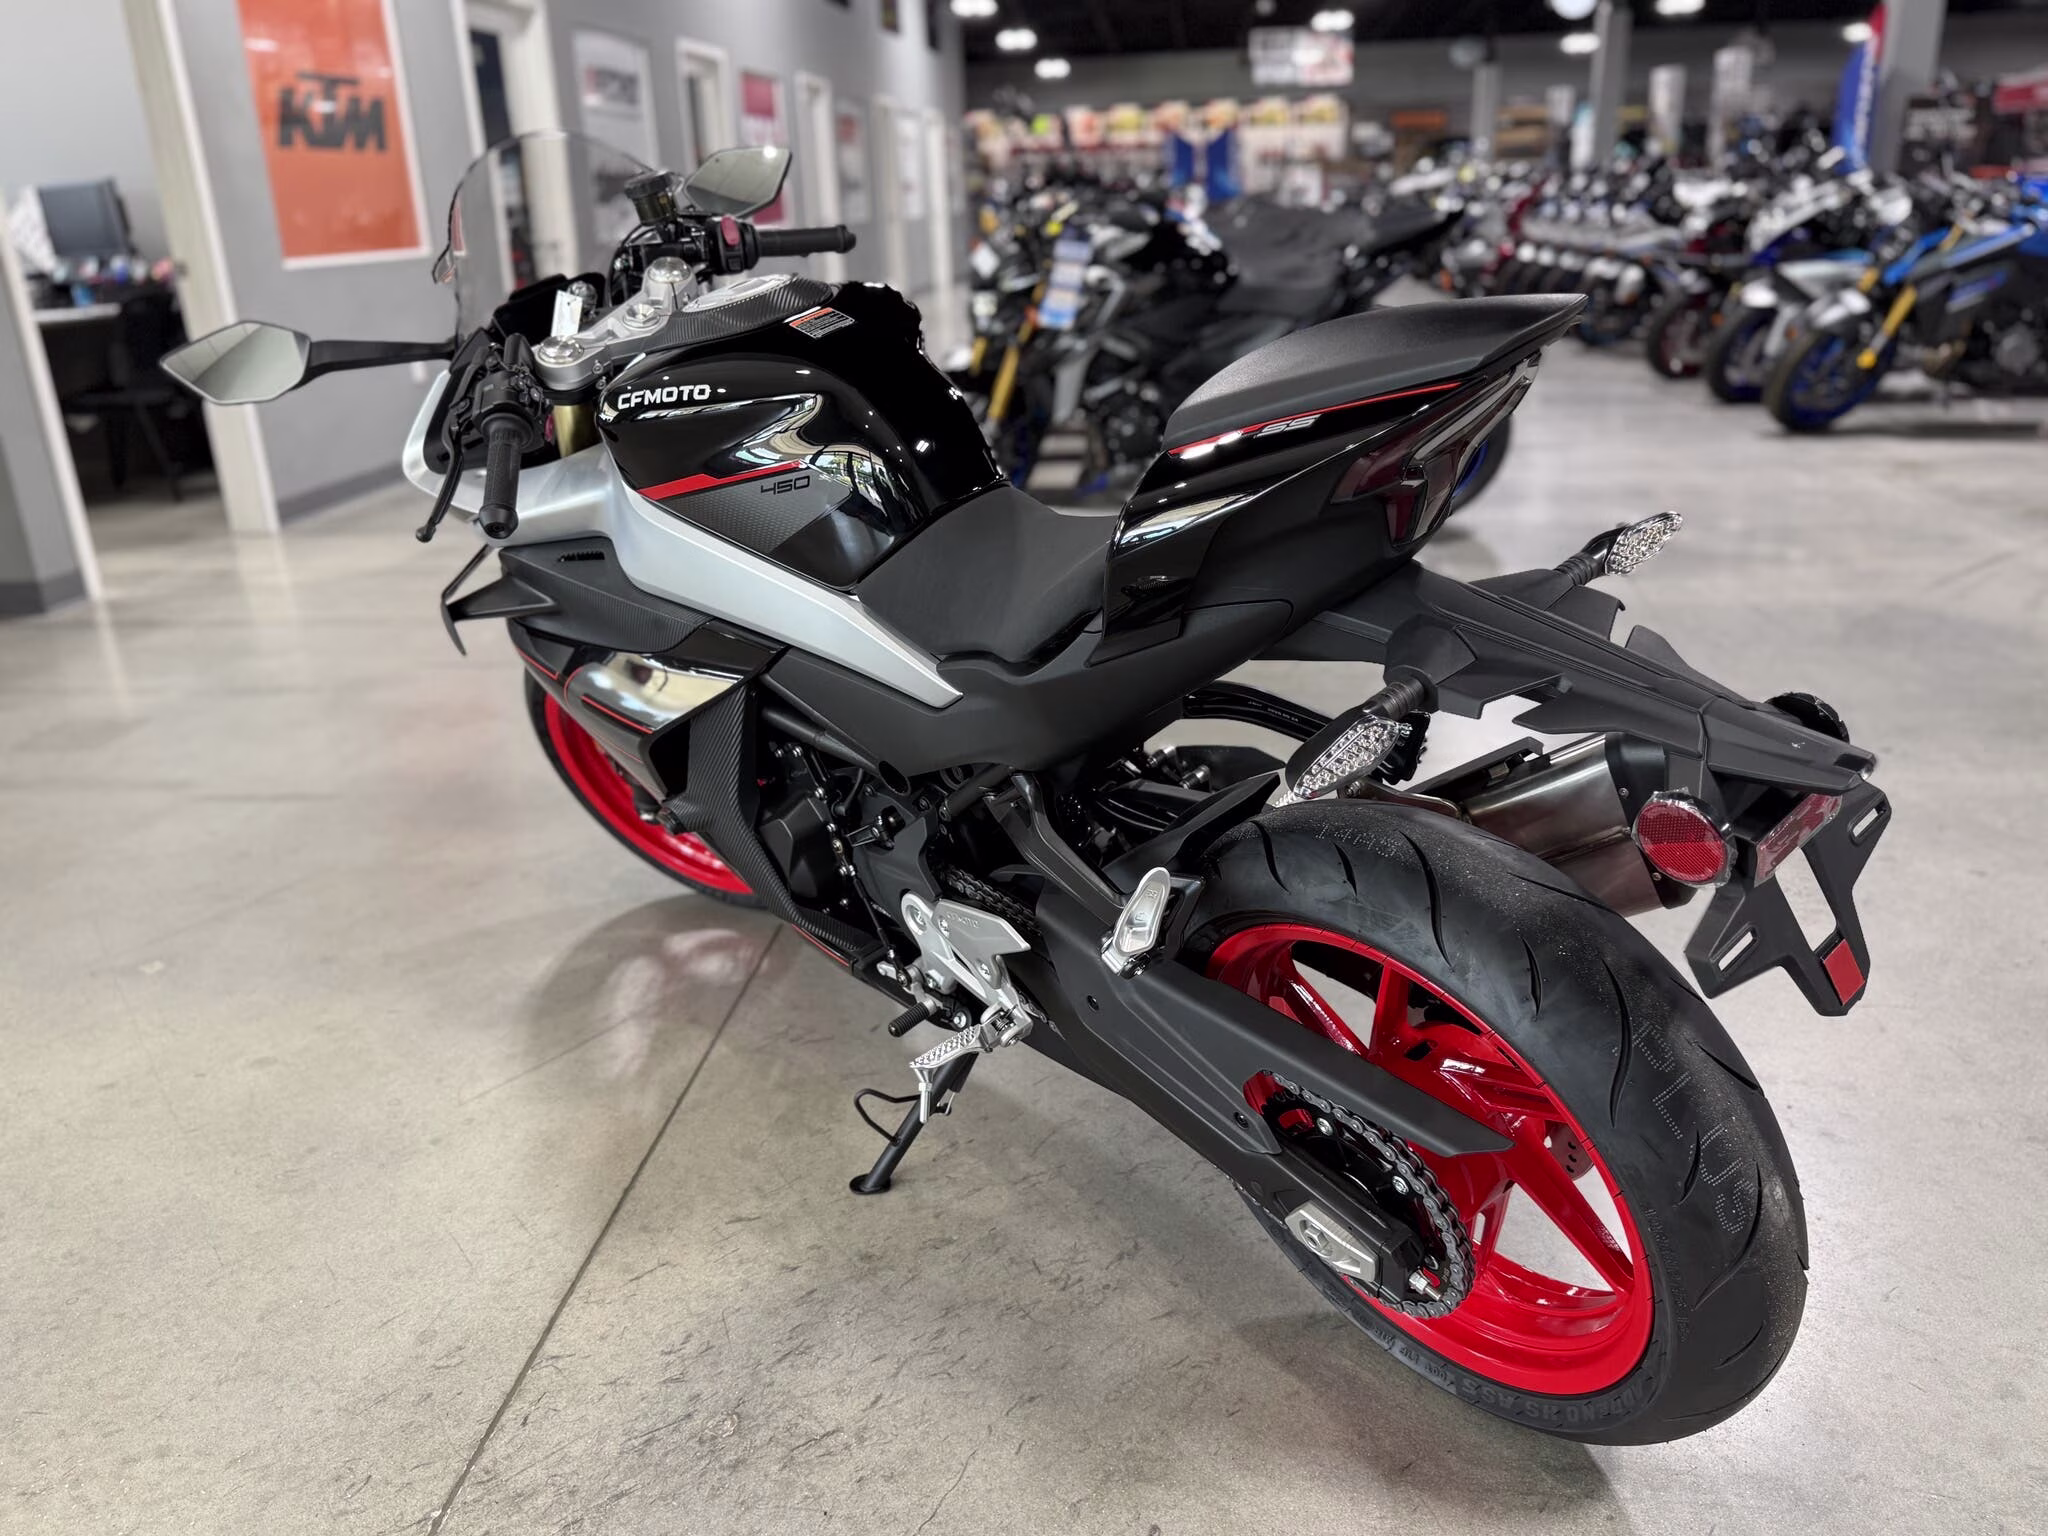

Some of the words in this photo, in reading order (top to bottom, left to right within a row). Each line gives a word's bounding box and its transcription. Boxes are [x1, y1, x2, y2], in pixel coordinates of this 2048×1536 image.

[279, 70, 388, 153] KTM
[617, 384, 711, 410] CFMOTO
[760, 475, 810, 495] 450
